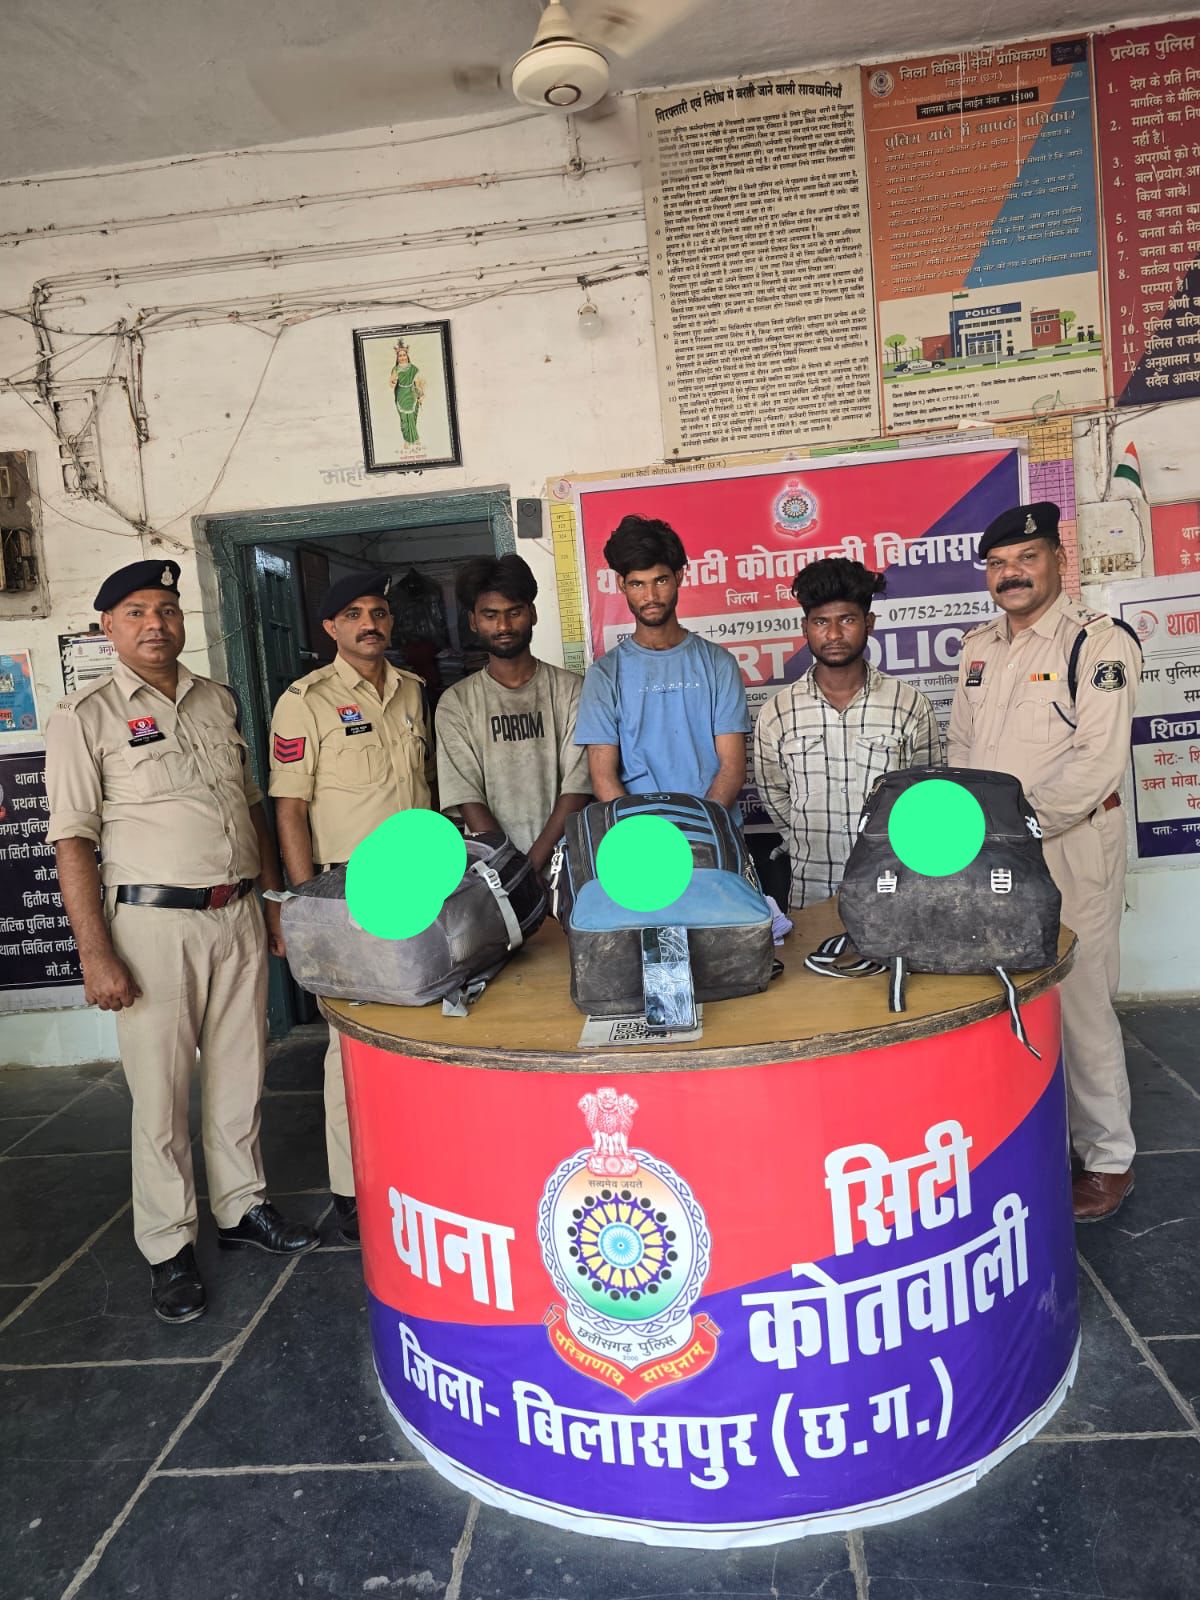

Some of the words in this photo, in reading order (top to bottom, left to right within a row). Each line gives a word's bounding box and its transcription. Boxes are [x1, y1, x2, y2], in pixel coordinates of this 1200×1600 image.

[1110, 39, 1150, 62] प्रत्येक
[1155, 33, 1195, 60] पुलिस
[900, 65, 926, 80] जिला
[996, 48, 1048, 66] प्राधिकरण
[1108, 83, 1118, 94] 1.
[1130, 75, 1146, 90] देश
[1151, 72, 1160, 87] के
[1164, 69, 1181, 86] प्रति
[655, 98, 688, 123] गिरफ्तारी
[691, 92, 702, 111] एवं
[704, 90, 724, 106] निरोध
[757, 81, 772, 96] जाने
[776, 80, 796, 95] वाली
[921, 105, 943, 115] नालसा
[964, 97, 983, 109] लाईन
[1011, 92, 1034, 102] 15100
[1130, 93, 1162, 109] नागरिक
[1165, 89, 1175, 105] के
[1110, 120, 1120, 131] 2.
[1132, 109, 1164, 128] मामलों
[1168, 111, 1181, 123] का
[1132, 129, 1149, 147] नहीं
[1153, 129, 1165, 145] है।
[1113, 157, 1123, 168] 3.
[1135, 145, 1171, 166] अपराधों
[1175, 145, 1188, 161] को
[1114, 176, 1125, 188] 4.
[1135, 171, 1152, 184] बल
[1155, 165, 1182, 184] प्रयोग
[1136, 185, 1161, 203] किया
[1116, 213, 1126, 225] 5.
[1137, 209, 1152, 222] वह
[1156, 205, 1182, 218] जनता
[1117, 232, 1128, 243] 6.
[1139, 226, 1165, 240] जनता
[1169, 221, 1183, 235] की
[1118, 251, 1128, 262] 7.
[1140, 245, 1166, 259] जनता
[1170, 243, 1185, 255] का
[1119, 269, 1130, 280] 8.
[1141, 259, 1169, 277] कर्तव्य
[1141, 281, 1172, 296] परम्परा
[1176, 278, 1188, 293] है।
[965, 307, 1002, 318] POLICE
[1120, 305, 1131, 317] 9.
[1143, 301, 1163, 314] उच्च
[1168, 294, 1190, 311] श्रेणी
[1122, 324, 1139, 336] 10.
[1144, 320, 1172, 336] पुलिस
[1122, 341, 1139, 354] 11.
[1145, 338, 1172, 354] पुलिस
[1122, 360, 1141, 373] 12.
[1146, 353, 1190, 371] अनुशासन
[1146, 373, 1168, 388] सदैव
[874, 532, 986, 571] बिलासपु
[1180, 549, 1190, 568] के
[725, 588, 759, 607] जिला
[705, 616, 800, 638] +947919301
[490, 711, 545, 742] PARAM
[15, 772, 39, 785] थाना
[1141, 777, 1166, 791] उक्त
[12, 797, 37, 810] प्रथम
[21, 819, 49, 838] पुलिस
[8, 843, 29, 860] सिटी
[32, 843, 56, 858] कोतव
[22, 892, 49, 909] द्वितीय
[26, 916, 54, 935] पुलिस
[21, 938, 53, 954] सिविल
[588, 1179, 618, 1189] सत्यमेव
[620, 1179, 643, 1189] जयते
[824, 1118, 975, 1257] सिटी
[388, 1186, 516, 1313] थाना
[741, 1191, 1031, 1371] कोतवाली
[639, 1334, 677, 1356] पुलिस
[553, 1327, 625, 1386] परित्राणाय
[398, 1321, 502, 1428] जिला-
[512, 1380, 759, 1490] बिलासपुर
